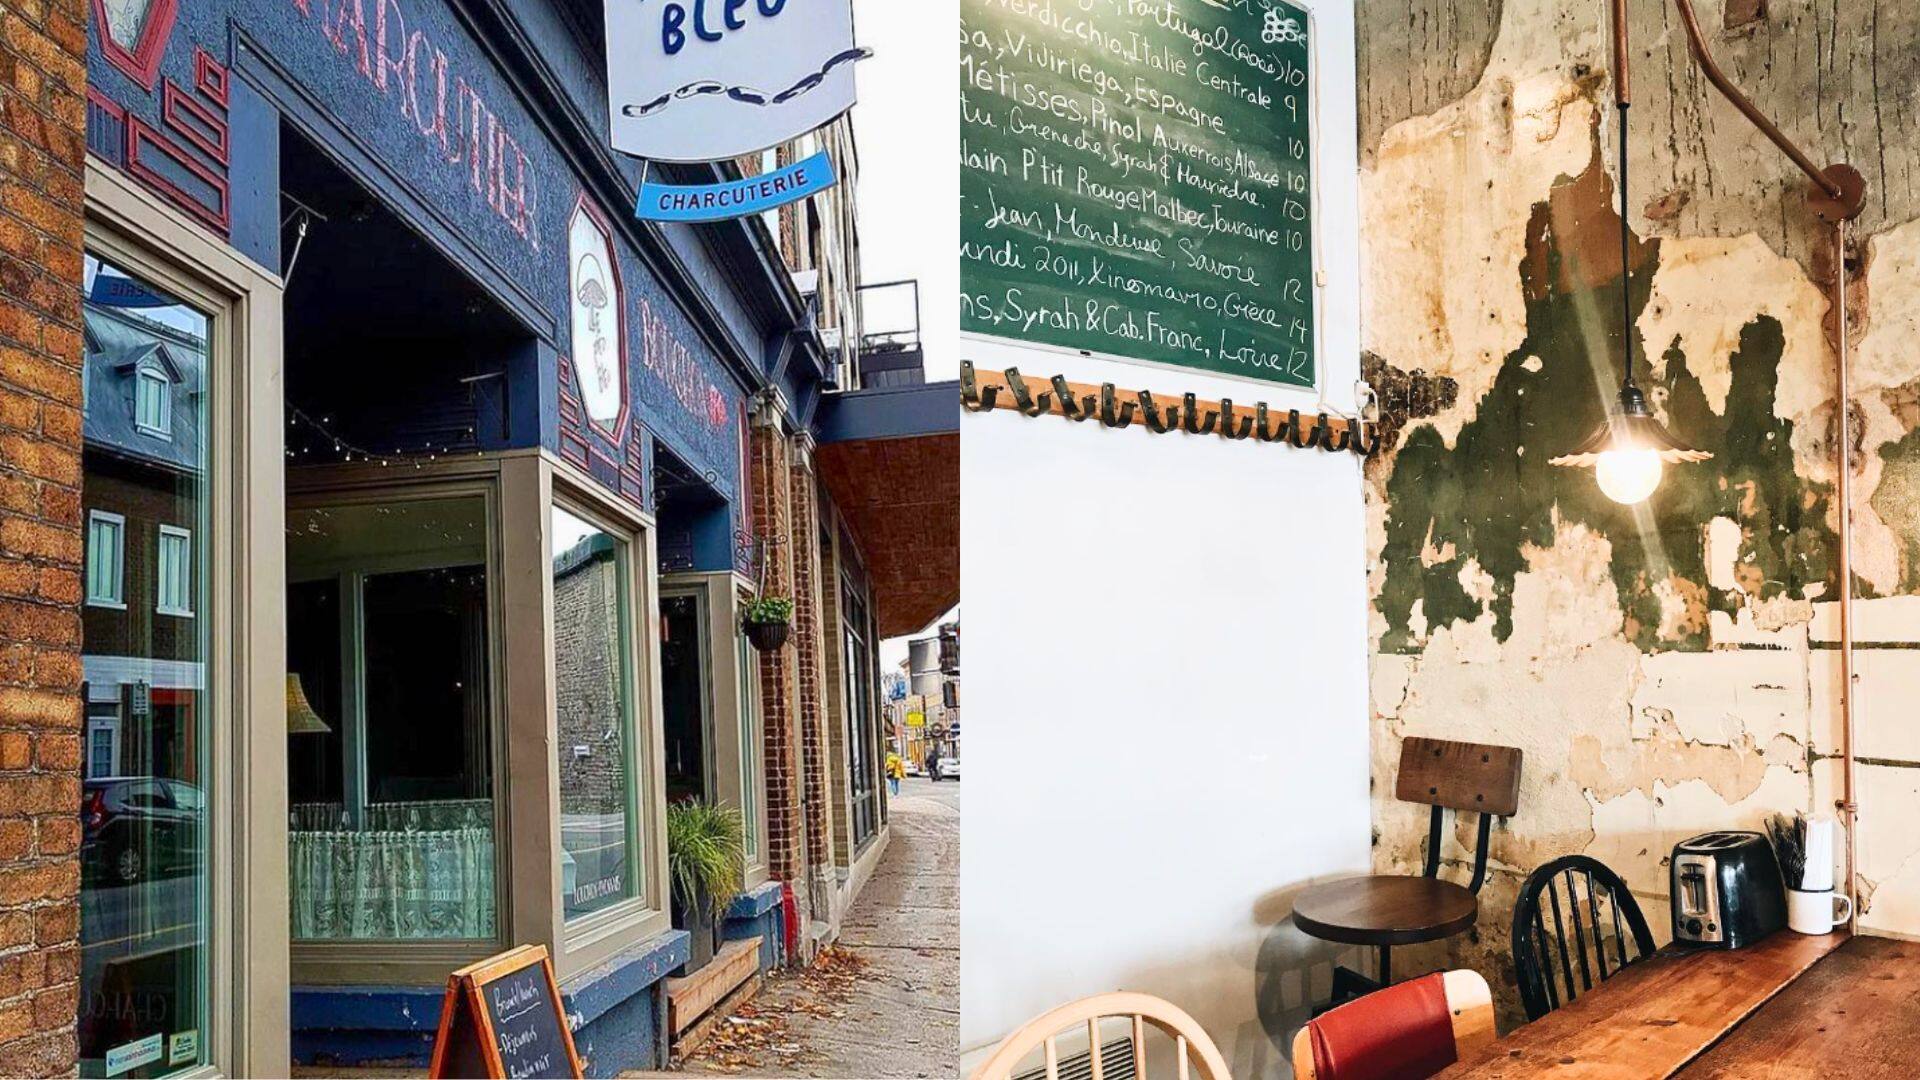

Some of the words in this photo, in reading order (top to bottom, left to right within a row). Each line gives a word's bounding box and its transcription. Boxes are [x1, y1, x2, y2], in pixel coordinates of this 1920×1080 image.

[1128, 31, 1187, 76] Italie
[1196, 62, 1272, 110] Centrale
[1284, 95, 1296, 123] 9
[1285, 60, 1305, 87] 10
[1134, 76, 1226, 135] Espagne
[1288, 136, 1304, 160] 10
[659, 169, 808, 211] CHARCUTERIE
[1283, 197, 1306, 221] 10
[1286, 229, 1303, 252] 10
[1004, 288, 1080, 332] Syrah
[1086, 299, 1099, 332] &
[1103, 305, 1144, 340] Cab.
[1219, 328, 1283, 371] Loire
[1287, 347, 1310, 382] 12
[1289, 316, 1308, 344] 14
